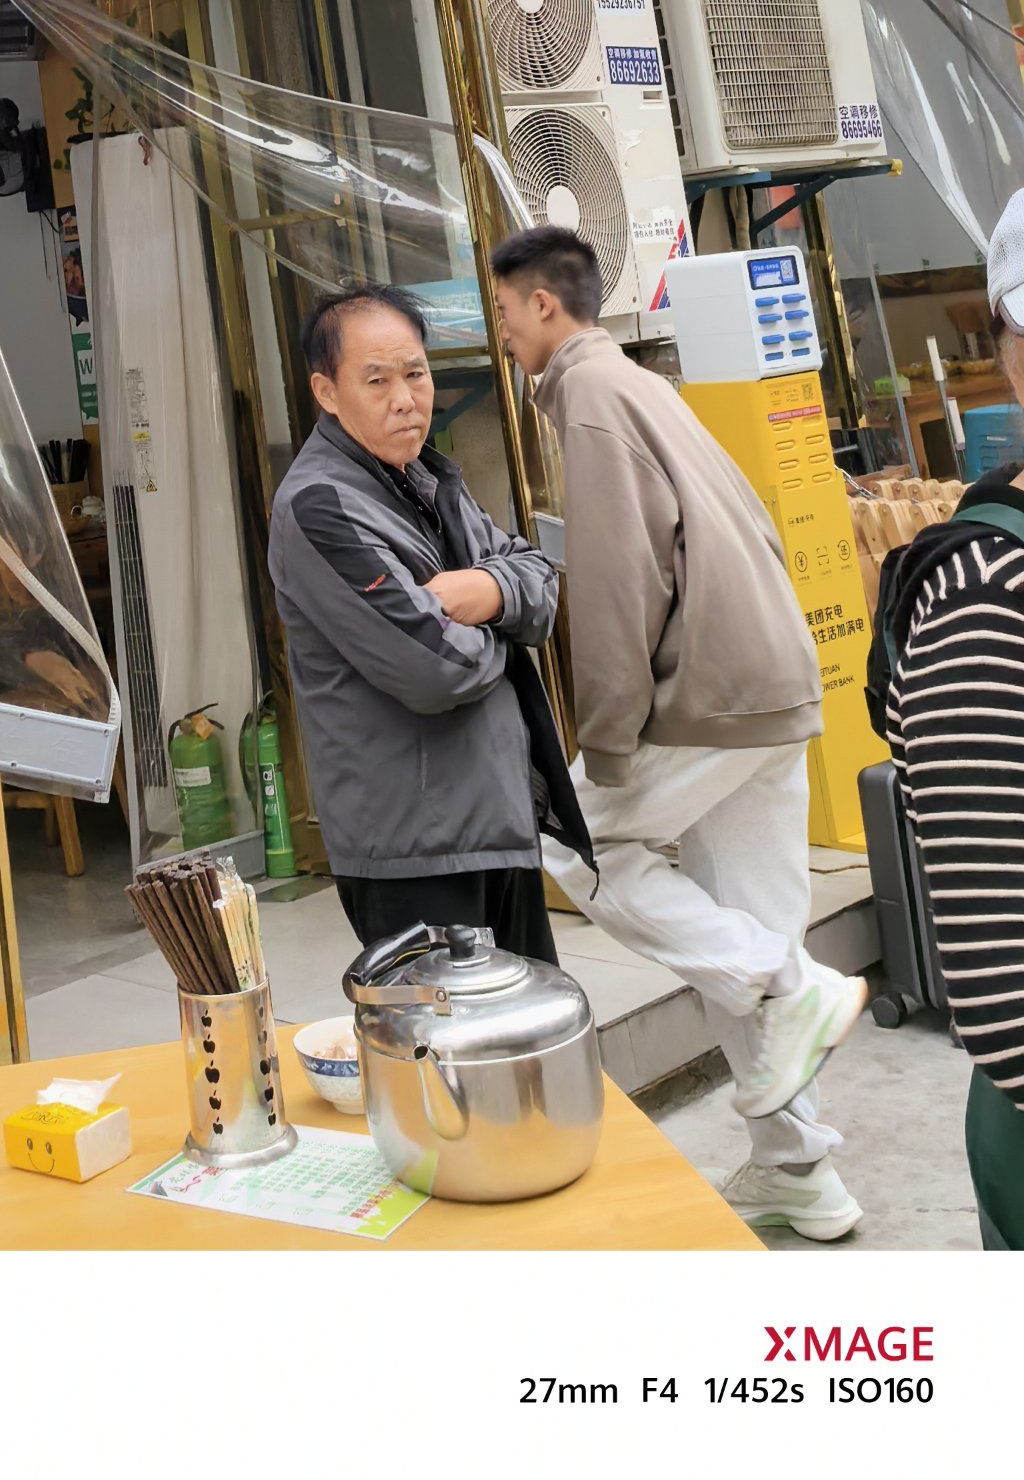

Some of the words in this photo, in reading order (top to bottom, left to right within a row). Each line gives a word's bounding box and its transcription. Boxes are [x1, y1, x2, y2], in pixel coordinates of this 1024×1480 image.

[610, 60, 660, 83] 86692633
[839, 104, 878, 120] 空调移修
[841, 120, 882, 139] 86695466
[805, 604, 843, 626] 美团充电
[820, 664, 840, 677] EITUAN
